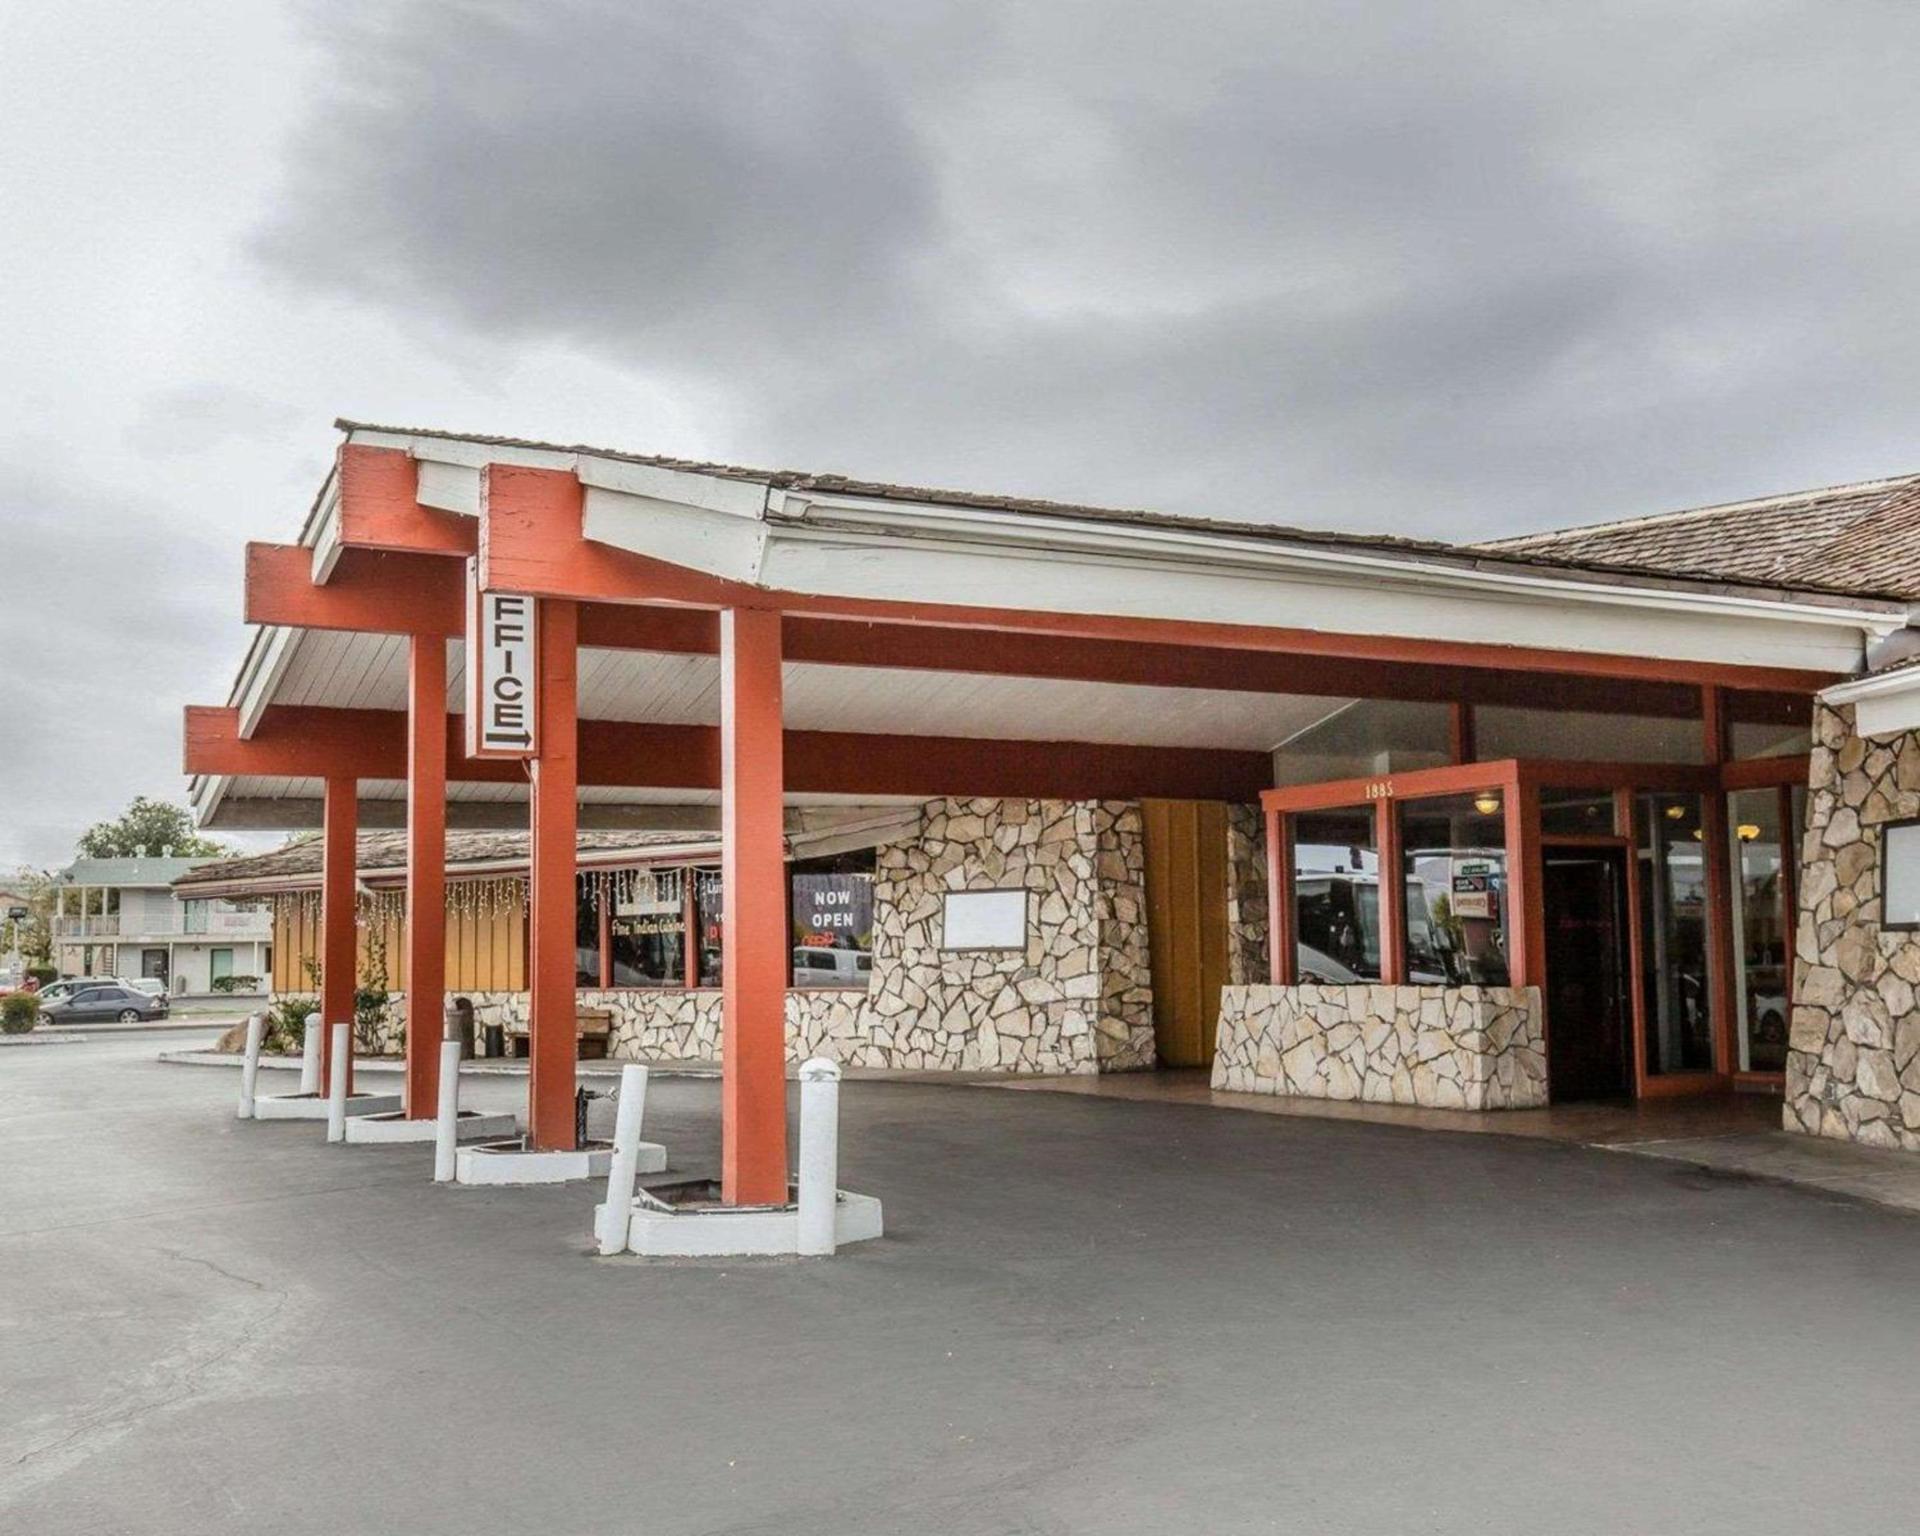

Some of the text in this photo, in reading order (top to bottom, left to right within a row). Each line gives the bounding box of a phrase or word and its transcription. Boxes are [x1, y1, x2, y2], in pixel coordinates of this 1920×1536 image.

[493, 597, 524, 728] FFICE
[1365, 780, 1394, 799] 1885
[814, 890, 851, 905] NOW
[812, 912, 854, 927] OPEN
